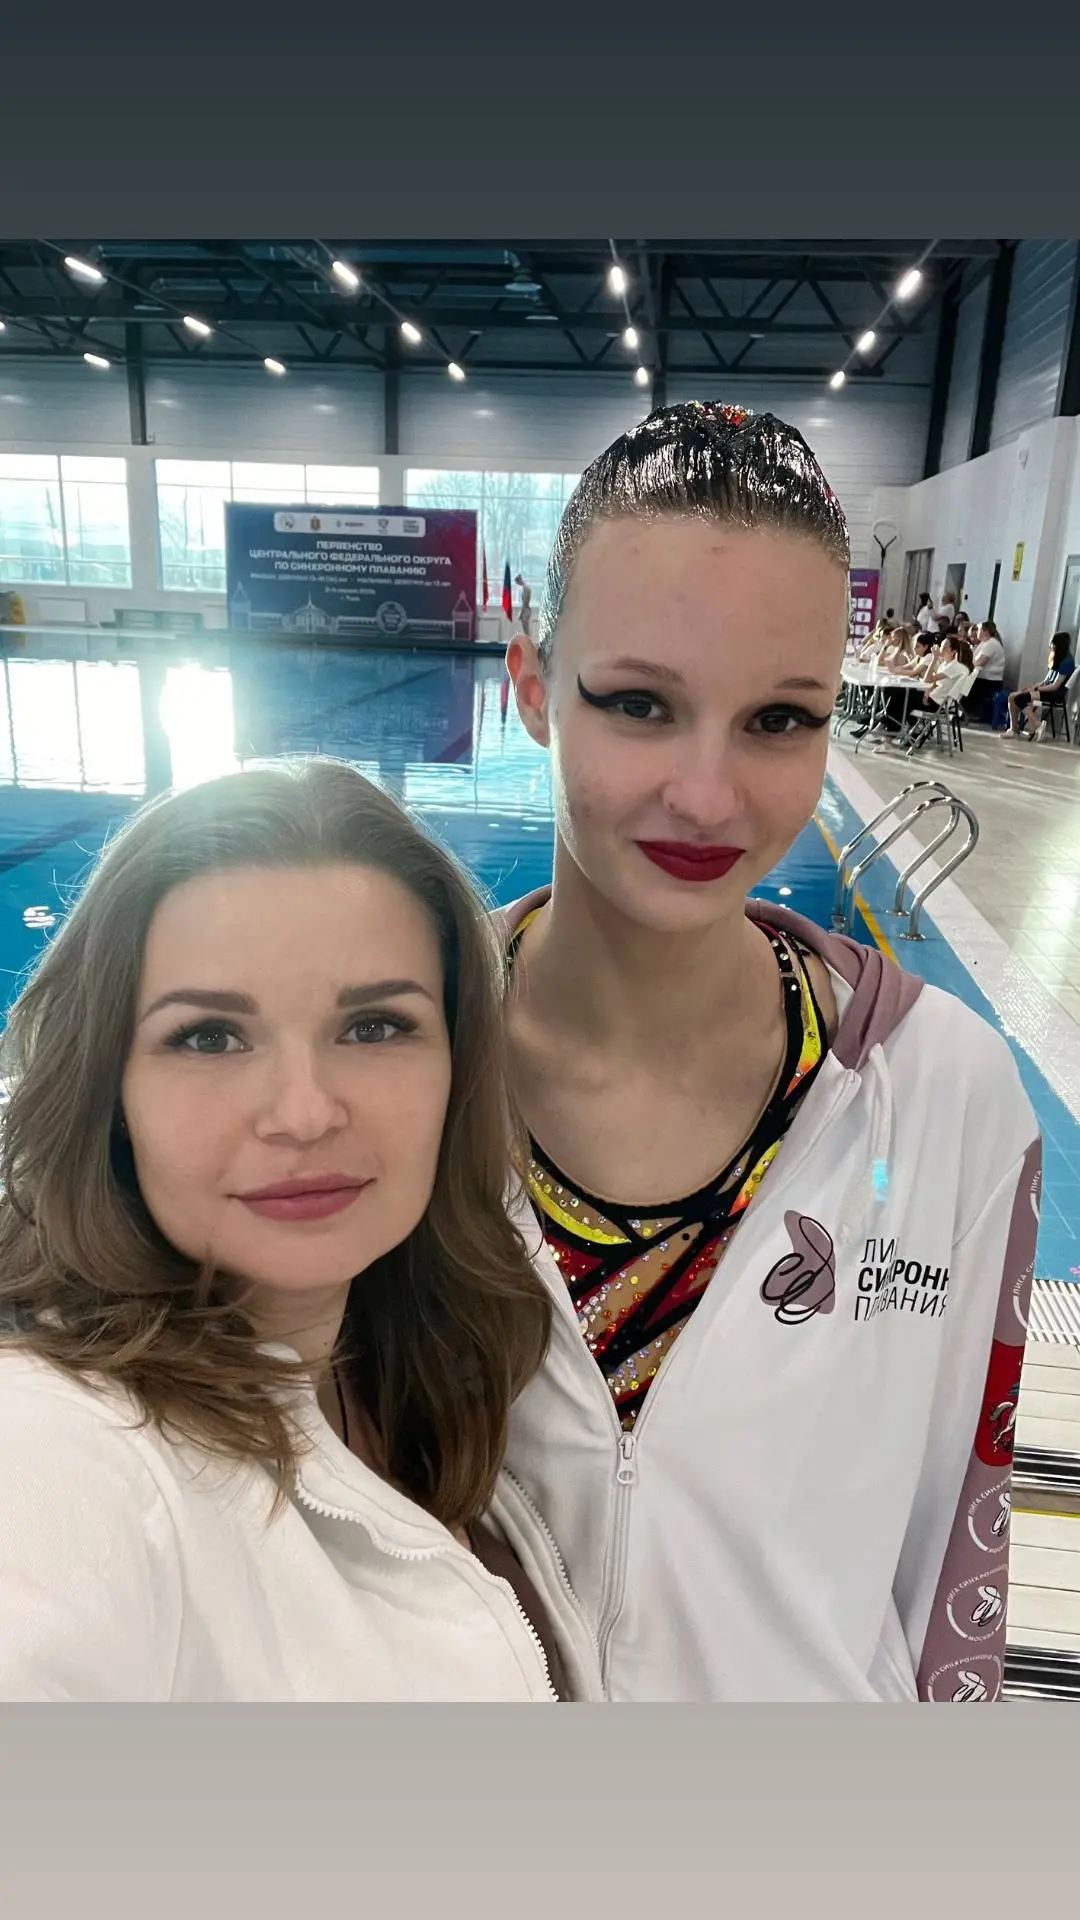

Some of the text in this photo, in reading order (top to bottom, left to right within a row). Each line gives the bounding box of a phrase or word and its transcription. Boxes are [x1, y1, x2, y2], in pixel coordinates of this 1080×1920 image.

[316, 540, 383, 552] ПЕРВЕНСТВО
[249, 549, 452, 566] ЦЕНТРАЛЬНОГО ФЕДЕРАЛЬНОГО ОКРУГА
[274, 561, 427, 576] ПО СИНХРОННОМУ ПЛАВАНИЮ
